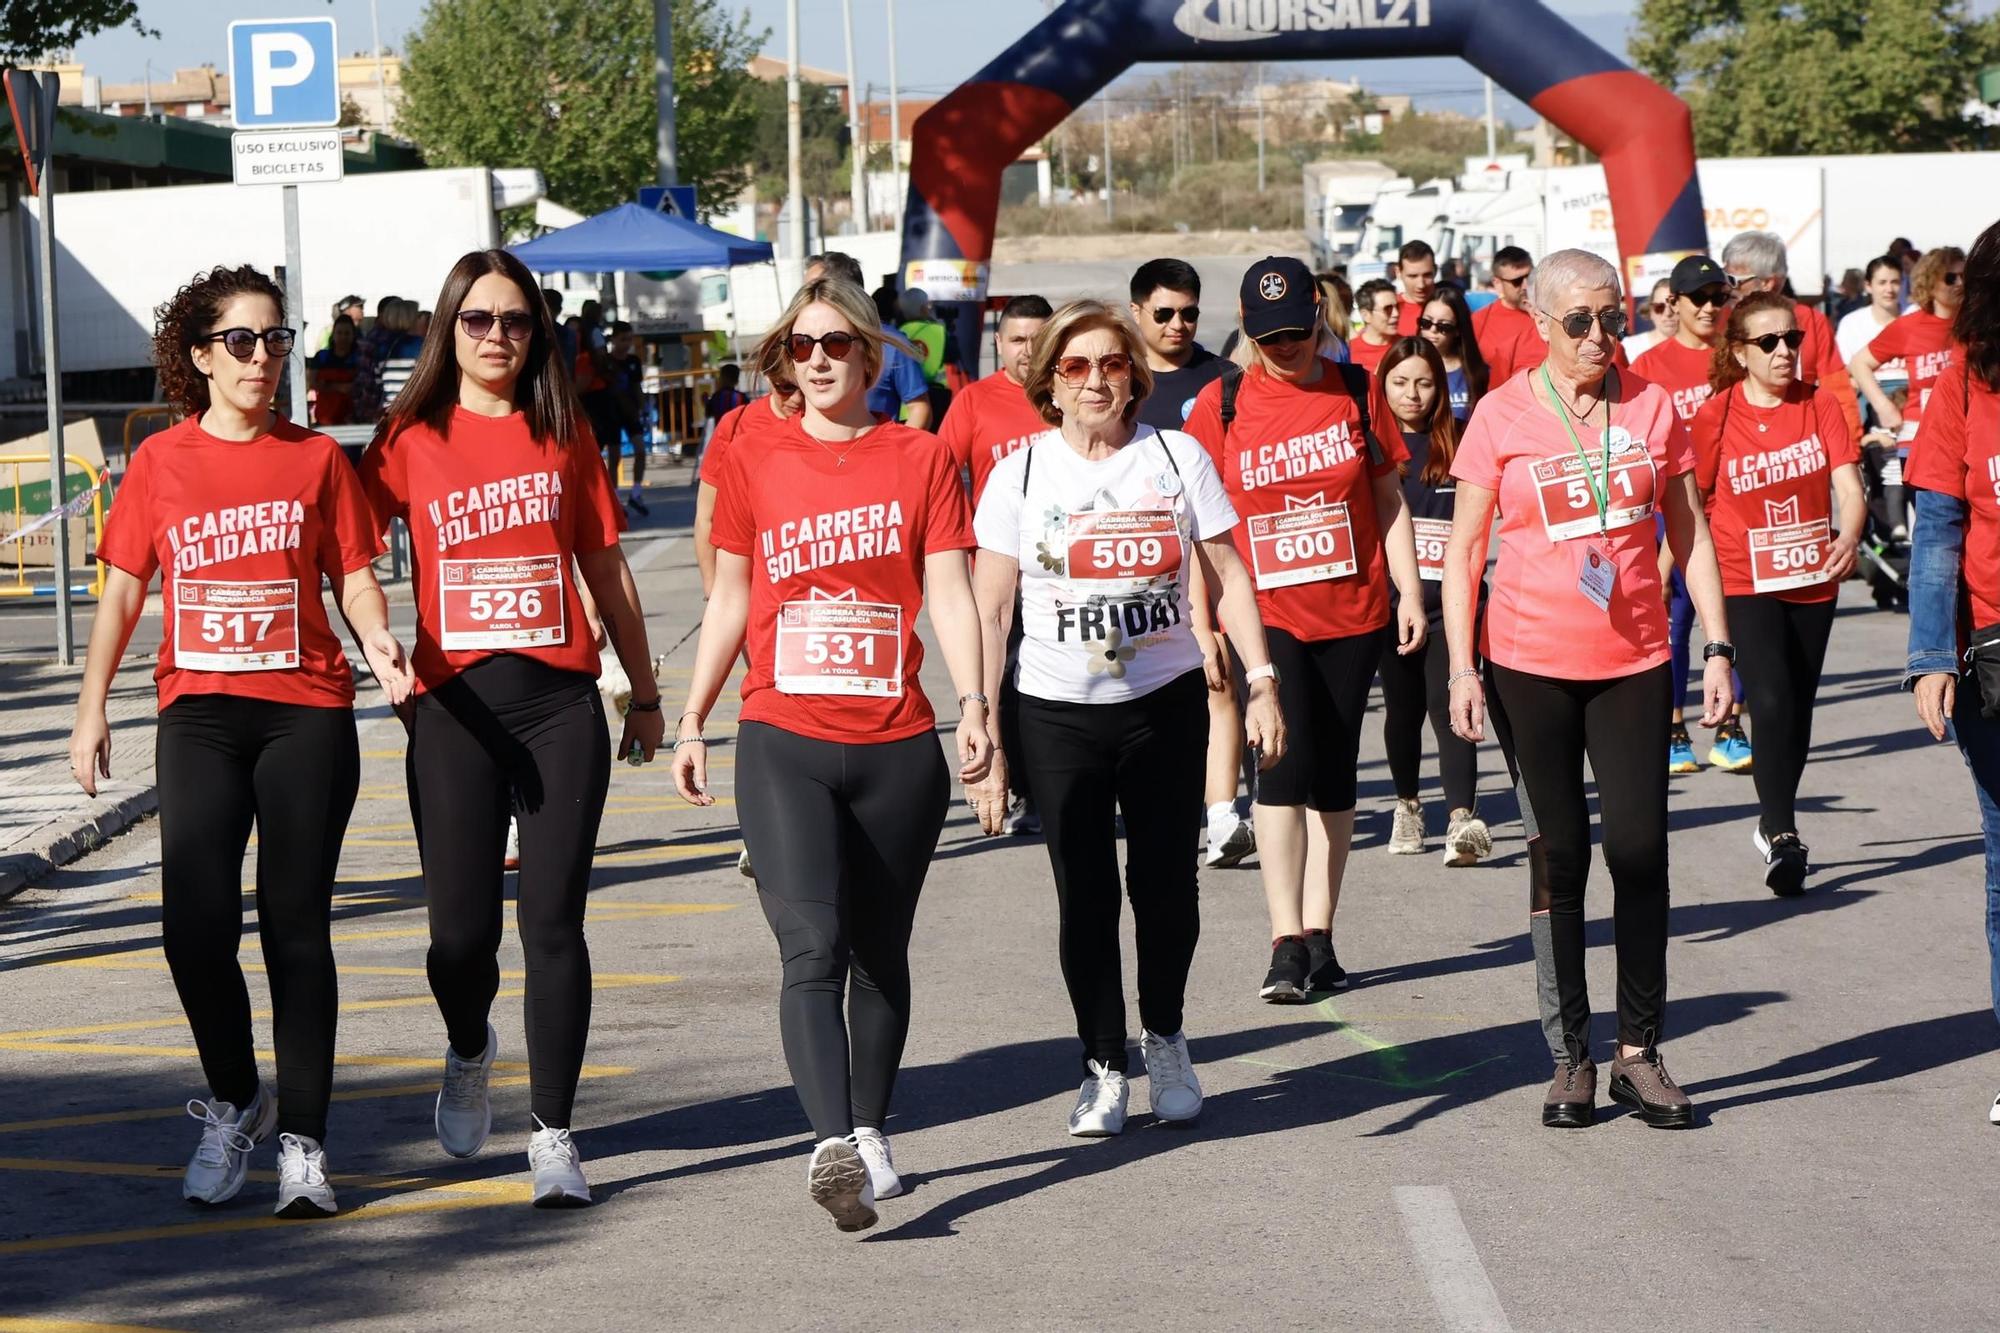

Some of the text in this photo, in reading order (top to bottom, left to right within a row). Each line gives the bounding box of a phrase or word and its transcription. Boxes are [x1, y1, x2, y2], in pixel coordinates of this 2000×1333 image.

[251, 32, 315, 115] P
[237, 140, 337, 154] USO EXCLUSIVO
[252, 162, 324, 175] BICICLETAS
[1240, 420, 1350, 471] II CARRERA
[1728, 432, 1822, 478] II CARRERA
[1241, 440, 1357, 491] SOLIDARIA
[1730, 450, 1827, 495] SOLIDARIA
[428, 470, 562, 527] II CARRERA
[167, 500, 305, 554] II CARRERA
[438, 496, 560, 552] SOLIDARIA
[761, 500, 904, 558] II CARRERA
[173, 525, 300, 579] SOLIDARIA
[766, 527, 902, 585] SOLIDARIA
[1092, 538, 1163, 569] 509
[1275, 531, 1335, 562] 600
[1416, 540, 1447, 561] 59
[1772, 544, 1820, 571] 506
[477, 566, 514, 574] CARRERA
[515, 562, 555, 572] SOLIDARIA
[211, 588, 248, 597] CARRERA
[249, 587, 293, 596] SOLIDARIA
[469, 589, 542, 621] 526
[201, 612, 275, 643] 517
[815, 608, 854, 616] CARRERA
[855, 610, 896, 619] SOLIDARIA
[804, 633, 875, 665] 531
